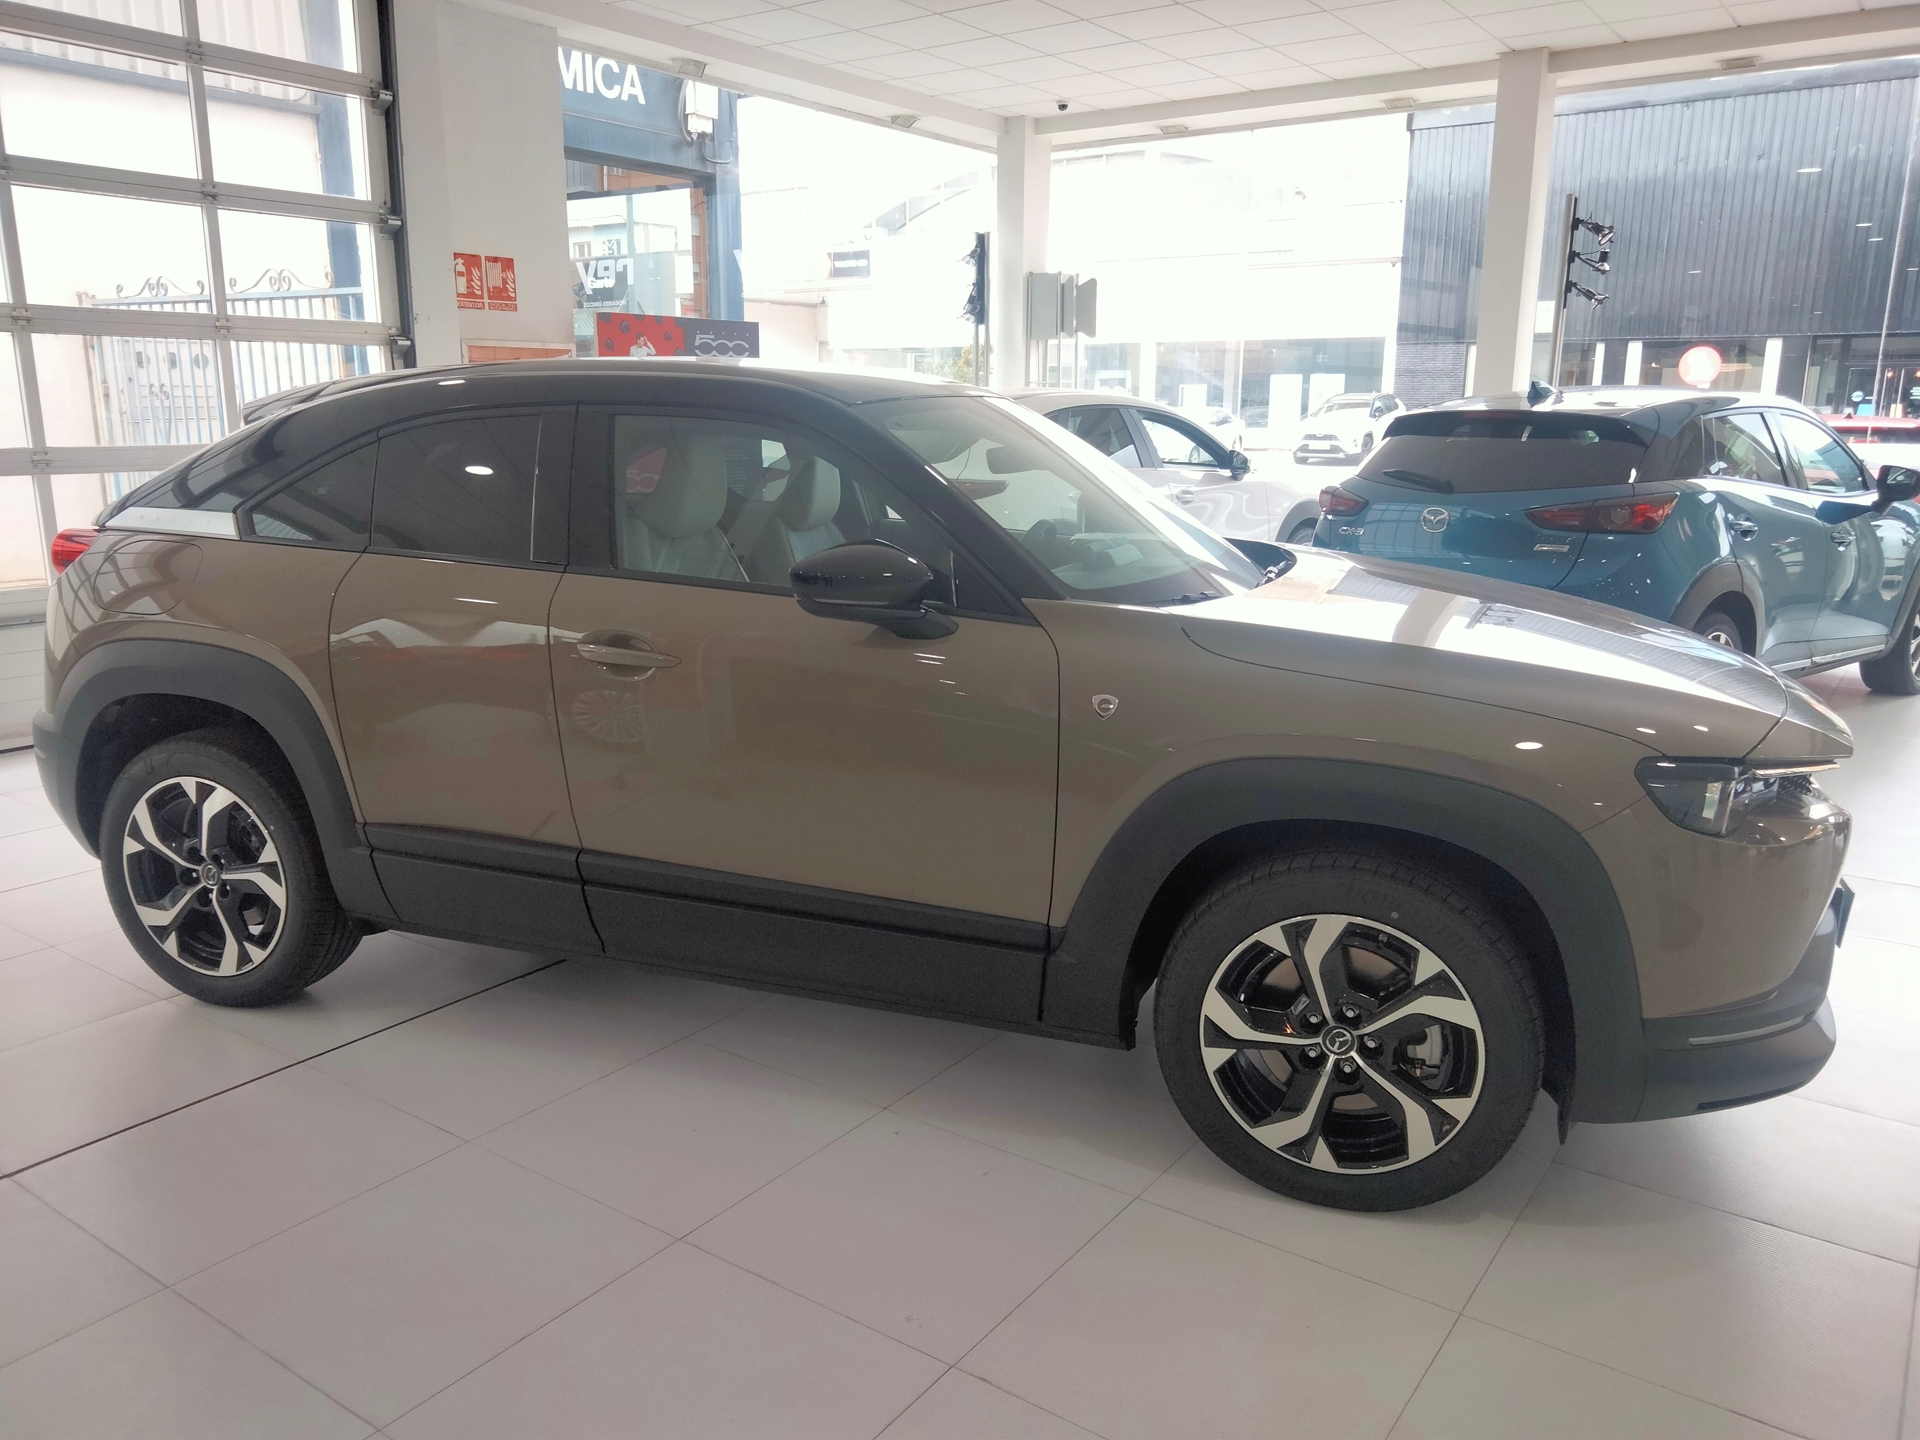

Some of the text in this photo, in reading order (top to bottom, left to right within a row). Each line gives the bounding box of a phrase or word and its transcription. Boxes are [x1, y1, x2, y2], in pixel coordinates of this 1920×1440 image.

[558, 46, 646, 105] MICA
[458, 301, 483, 309] EXTINTOR
[694, 334, 750, 357] 500
[139, 514, 211, 525] MAZDA
[1338, 526, 1365, 535] CX-3
